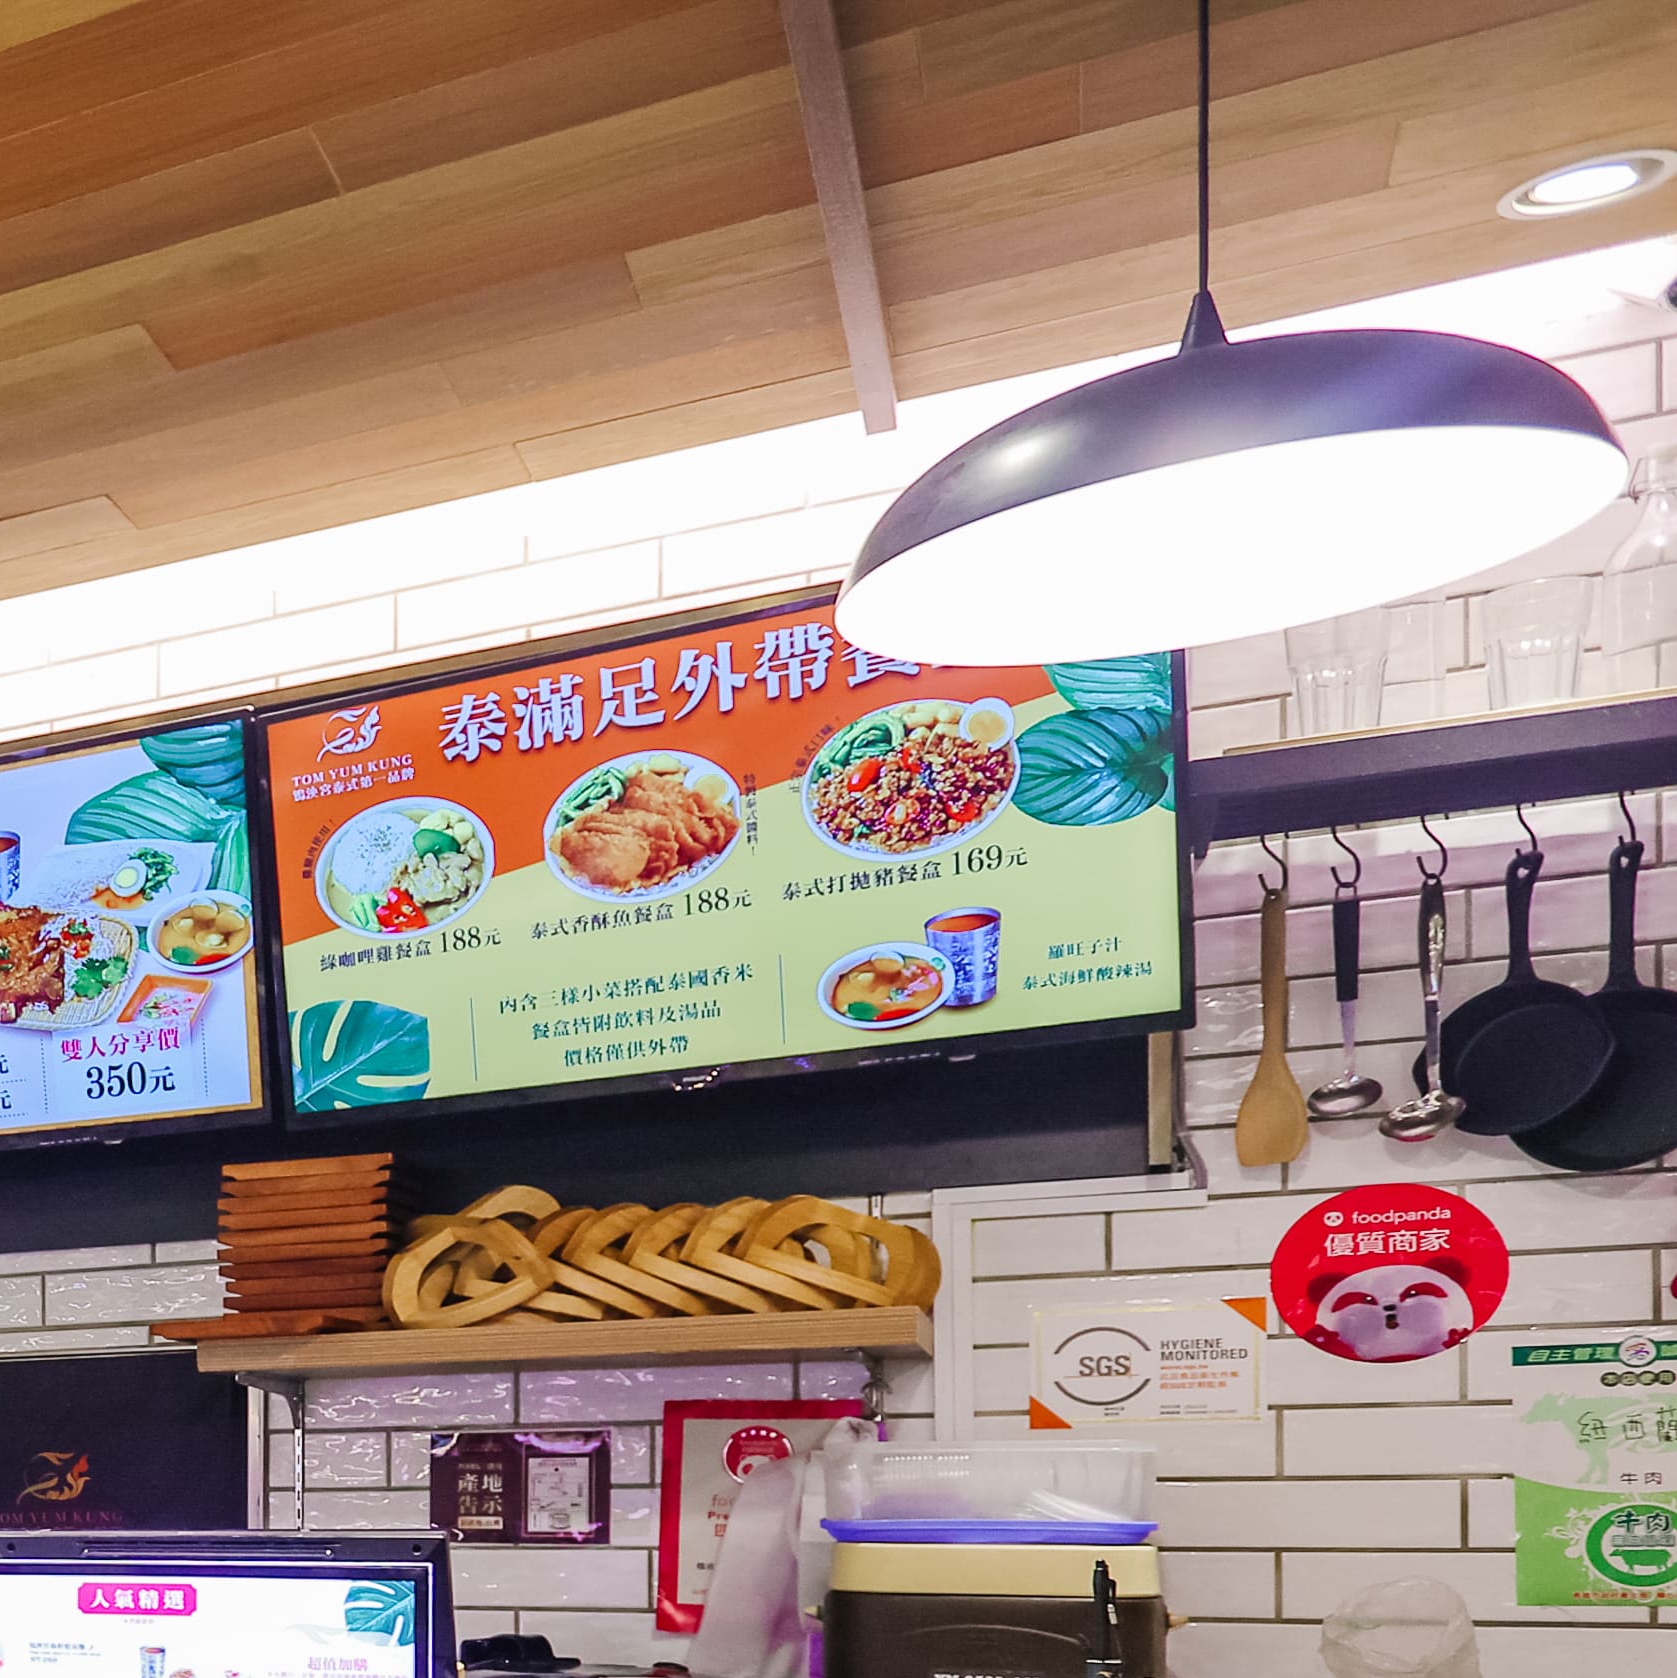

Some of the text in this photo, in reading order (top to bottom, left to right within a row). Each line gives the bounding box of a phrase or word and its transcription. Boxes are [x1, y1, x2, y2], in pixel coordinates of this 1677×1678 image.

[291, 754, 413, 787] TOM YUM KUNG
[782, 843, 1029, 902] 泰式打拋豬餐盒 169元
[530, 886, 753, 940] 泰式香酥魚餐盒 188元
[439, 926, 502, 954] 188元
[1022, 961, 1153, 991] 泰式海鮮酸辣湯
[531, 999, 722, 1040] 餐盒皆附飲料及湯品
[60, 1026, 181, 1063] 雙人分享價
[564, 1034, 690, 1068] 價格僅供外帶
[86, 1061, 176, 1100] 350元
[1351, 1206, 1451, 1226] foodpanda
[1324, 1228, 1451, 1257] 優質商家
[1160, 1338, 1224, 1350] HYGIENE
[1160, 1348, 1249, 1361] MONITORED
[1527, 1347, 1614, 1363] 自主管理
[1079, 1354, 1131, 1377] SGS
[1620, 1472, 1663, 1486] 牛肉
[1614, 1510, 1671, 1534] 牛肉
[89, 1586, 186, 1611] 人氣精選
